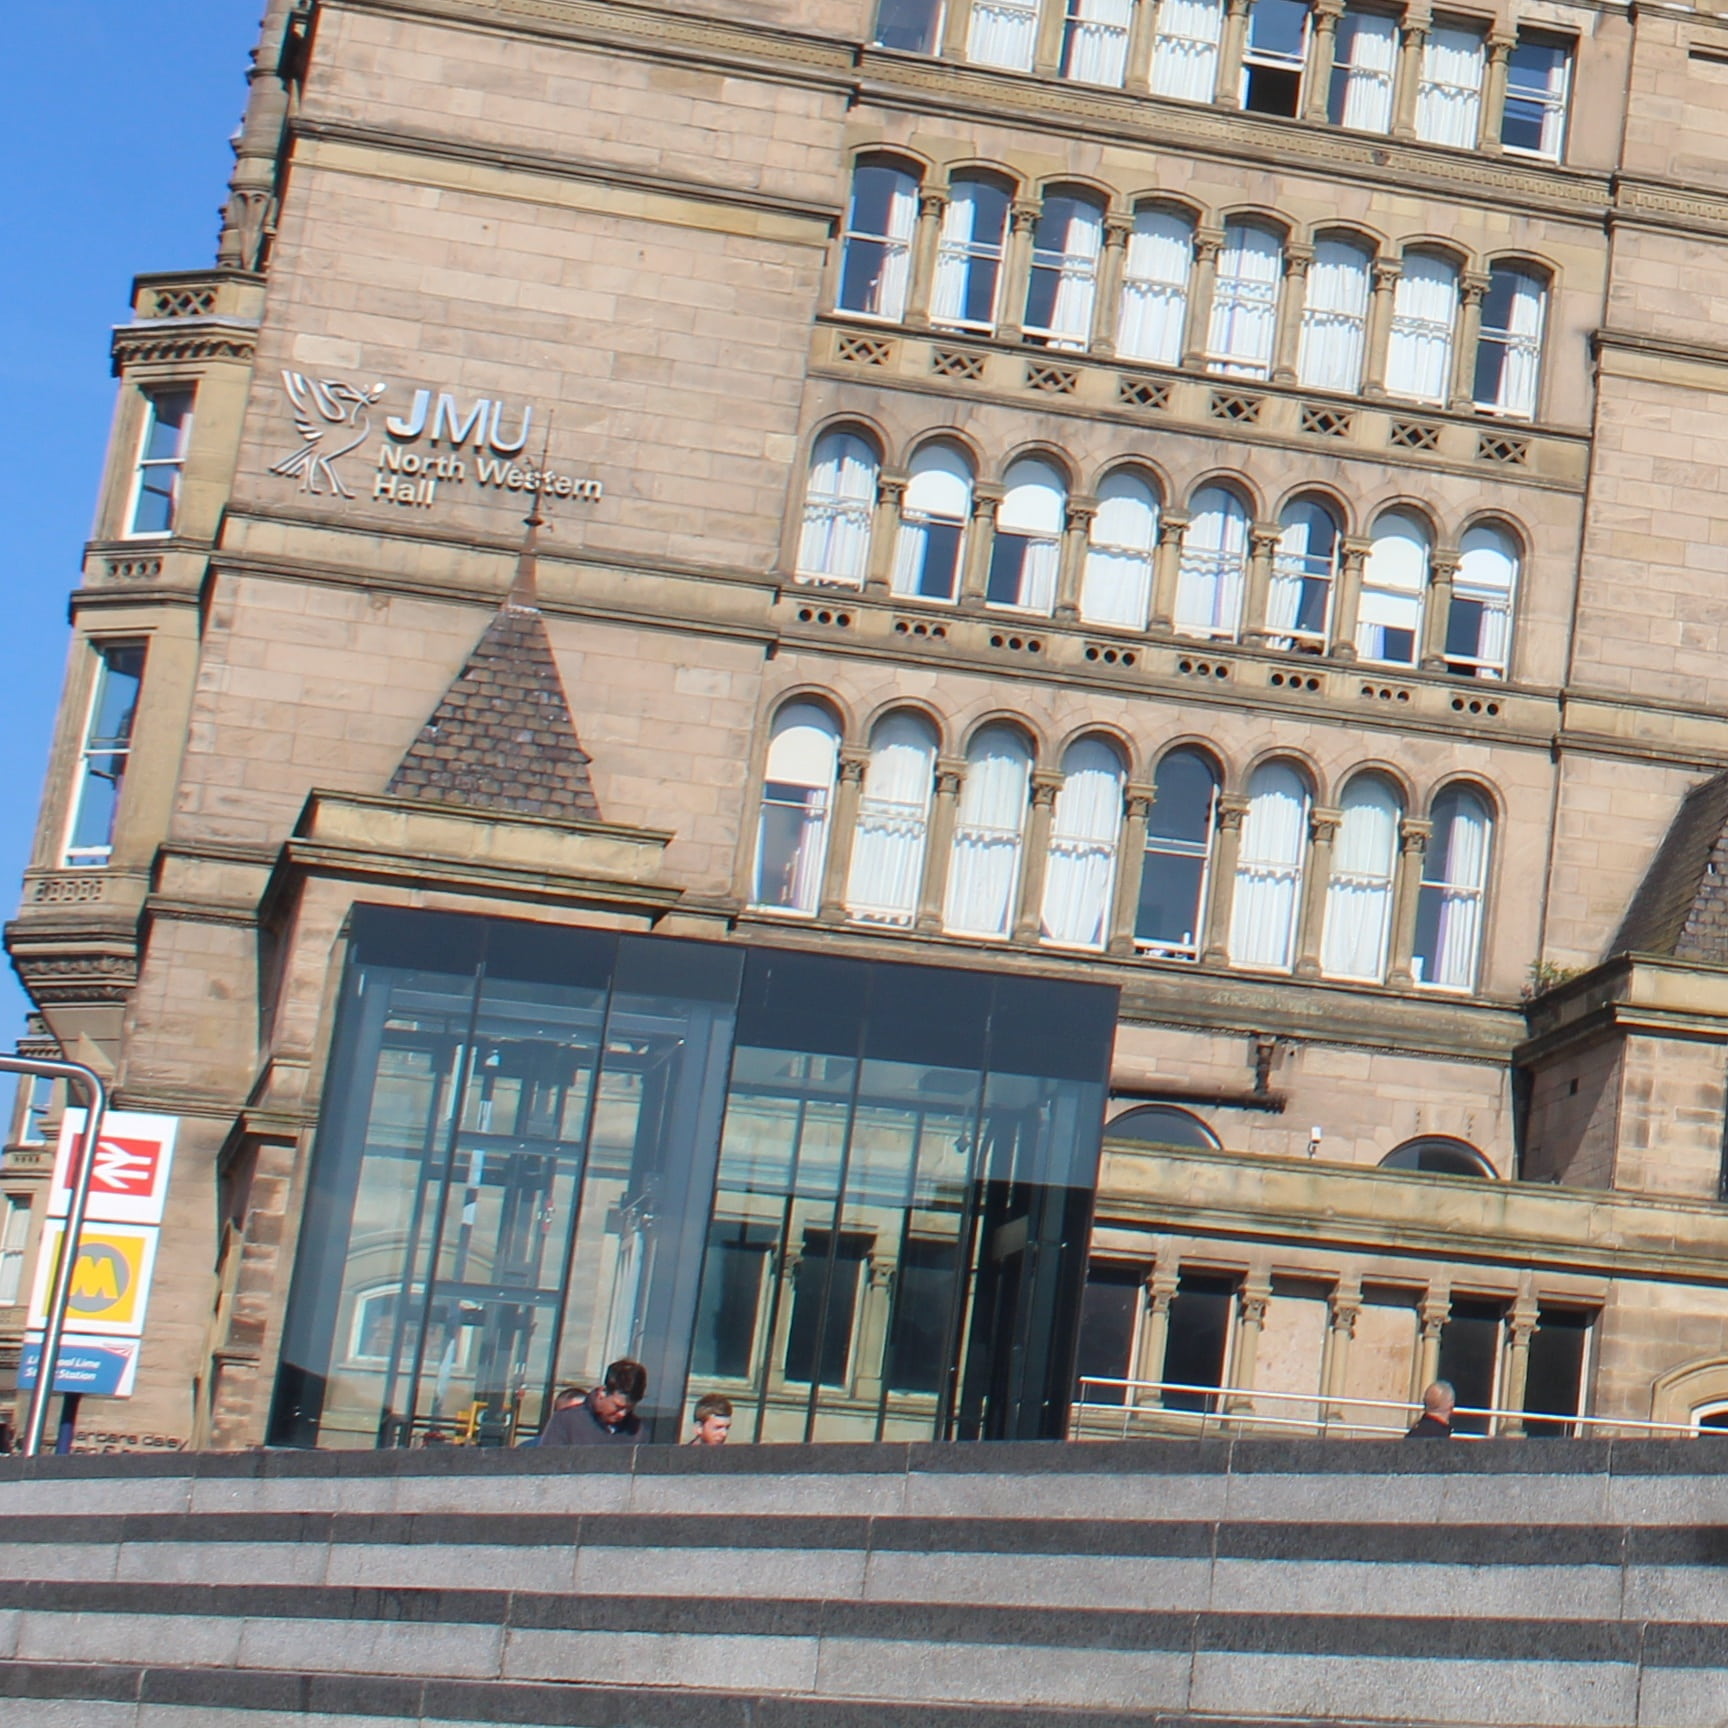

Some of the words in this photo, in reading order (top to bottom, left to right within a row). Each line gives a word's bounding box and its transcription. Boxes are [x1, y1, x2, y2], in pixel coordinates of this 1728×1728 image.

[386, 389, 532, 453] JMU
[380, 444, 465, 479] North
[476, 457, 604, 500] Western
[374, 474, 437, 506] Hall
[59, 1368, 97, 1381] Station
[74, 1356, 101, 1369] Lime
